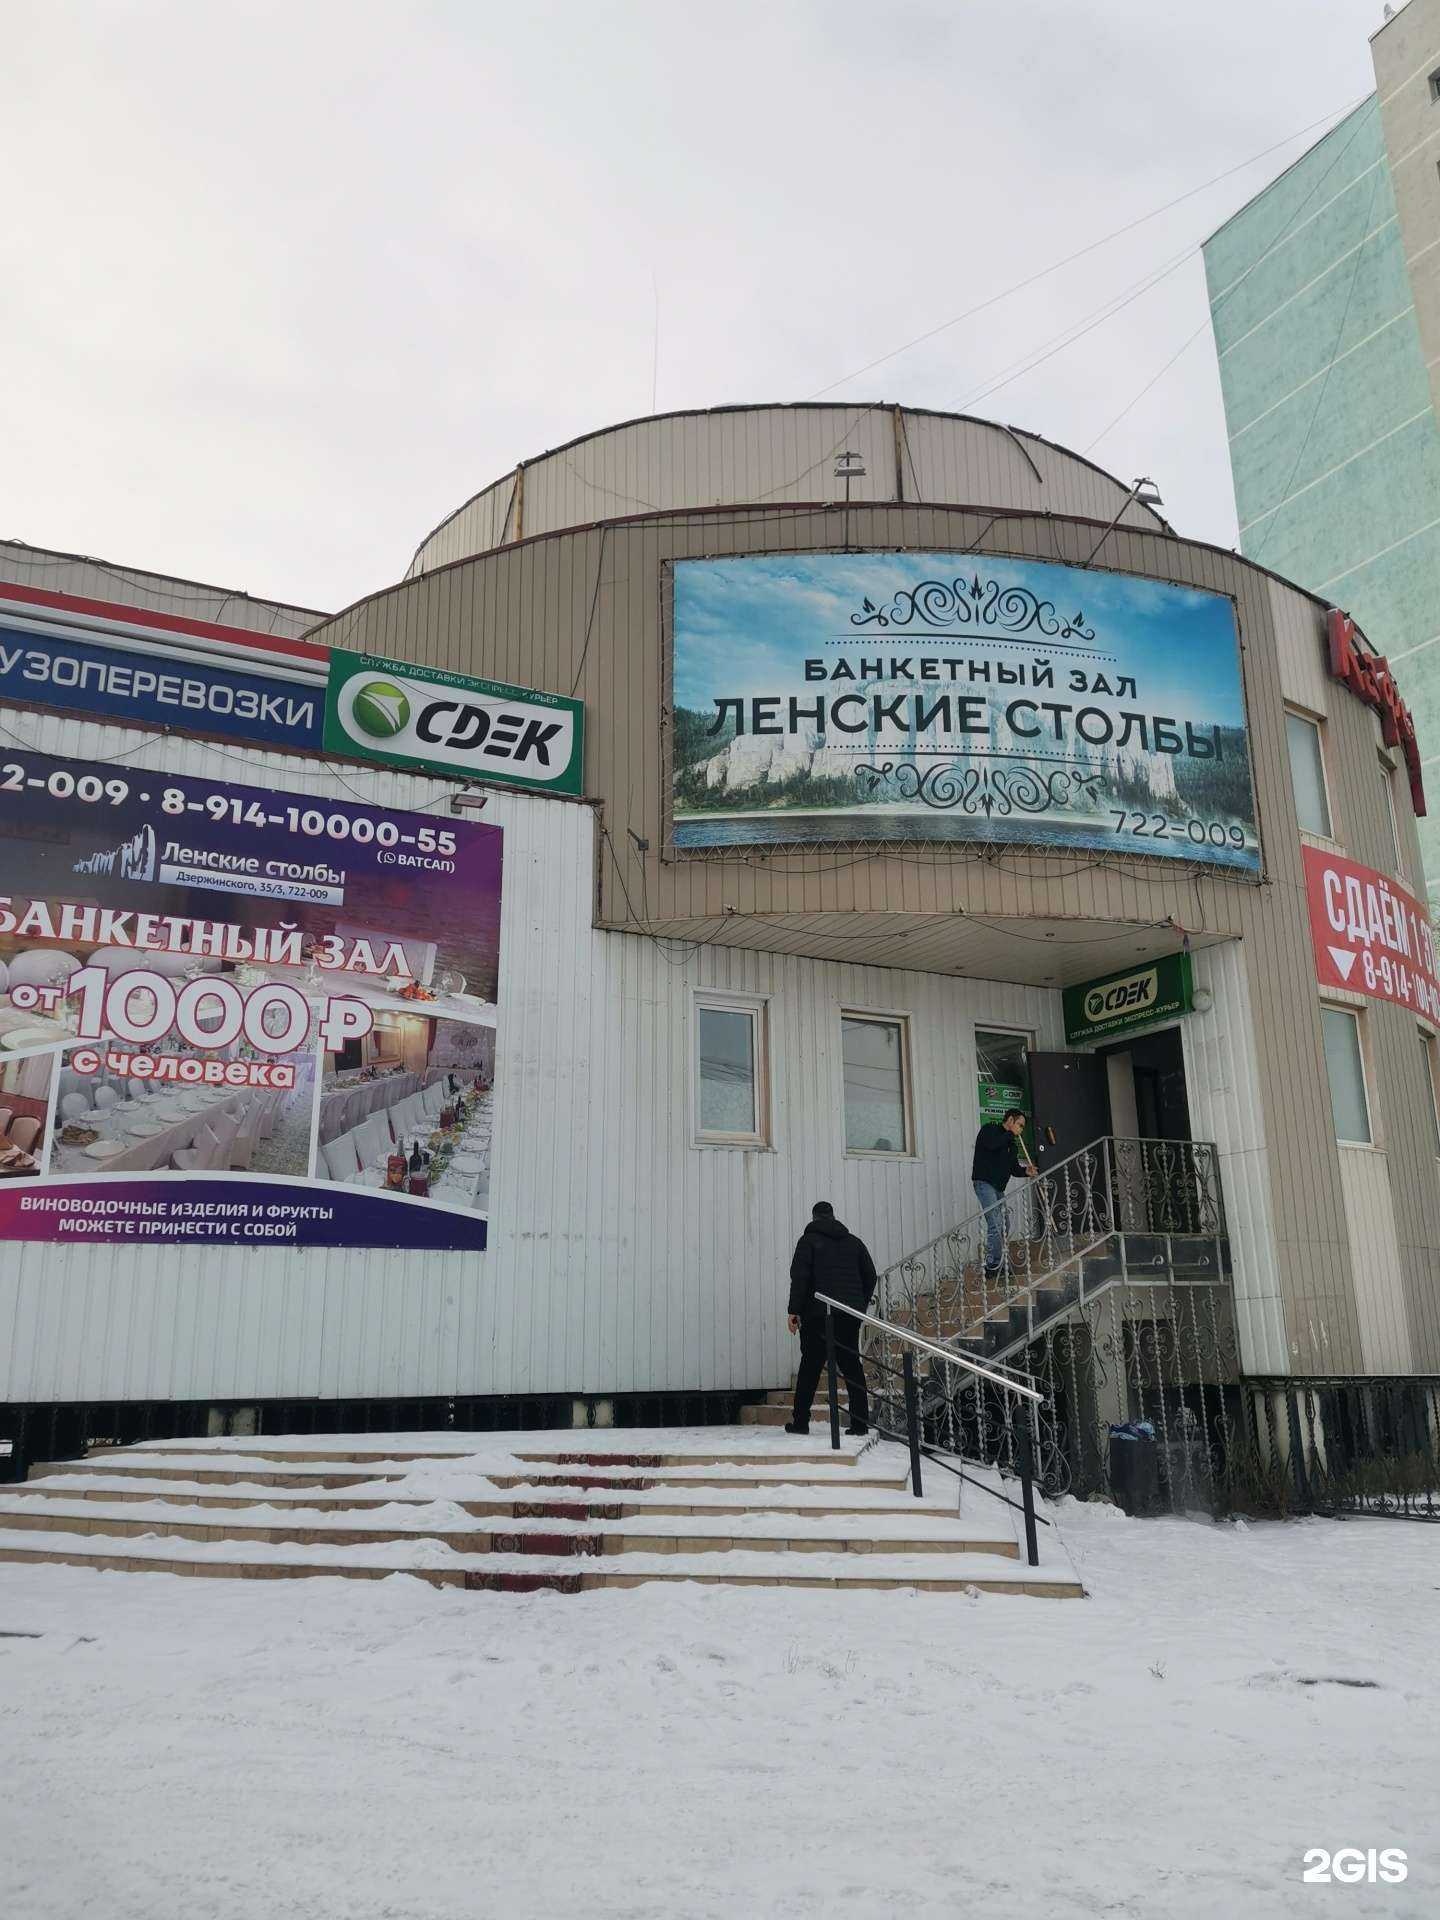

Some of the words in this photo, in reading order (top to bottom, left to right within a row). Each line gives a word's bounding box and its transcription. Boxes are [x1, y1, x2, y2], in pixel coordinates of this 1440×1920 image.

[360, 657, 407, 674] СЛУЖБА
[408, 667, 466, 686] ДОСТАВКИ
[804, 657, 1055, 690] БАНКЕТНЫЙ
[1069, 668, 1137, 700] ЗАЛ
[416, 701, 564, 766] CDEK
[706, 694, 990, 736] ЛЕНСКИЕ
[1005, 699, 1223, 761] СТОЛБЫ
[161, 788, 457, 856] 8-914-10000-55
[1110, 809, 1247, 851] 722-009
[161, 842, 260, 873] Ленские
[265, 860, 346, 884] столбы
[176, 872, 257, 891] Дзержинского,
[259, 882, 286, 896] 35/3,
[288, 885, 328, 900] 722-009
[1323, 869, 1412, 960] СДАЁМ
[0, 897, 304, 967] БАНКЕТНЫЙ
[316, 935, 413, 977] ЗАЛ
[10, 984, 64, 1011] от
[66, 965, 311, 1055] 1000
[1105, 977, 1153, 1011] CDEK
[72, 1049, 100, 1075] с
[106, 1052, 297, 1090] человека
[20, 1196, 167, 1216] ВИНОВОДОЧНЫЕ
[171, 1202, 248, 1217] ИЗДЕЛИЯ
[251, 1204, 264, 1217] И
[266, 1203, 334, 1220] ФРУКТЫ
[58, 1218, 135, 1234] МОЖЕТЕ
[139, 1220, 229, 1236] ПРИНЕСТИ
[230, 1222, 241, 1236] С
[244, 1220, 297, 1237] СОБОЙ
